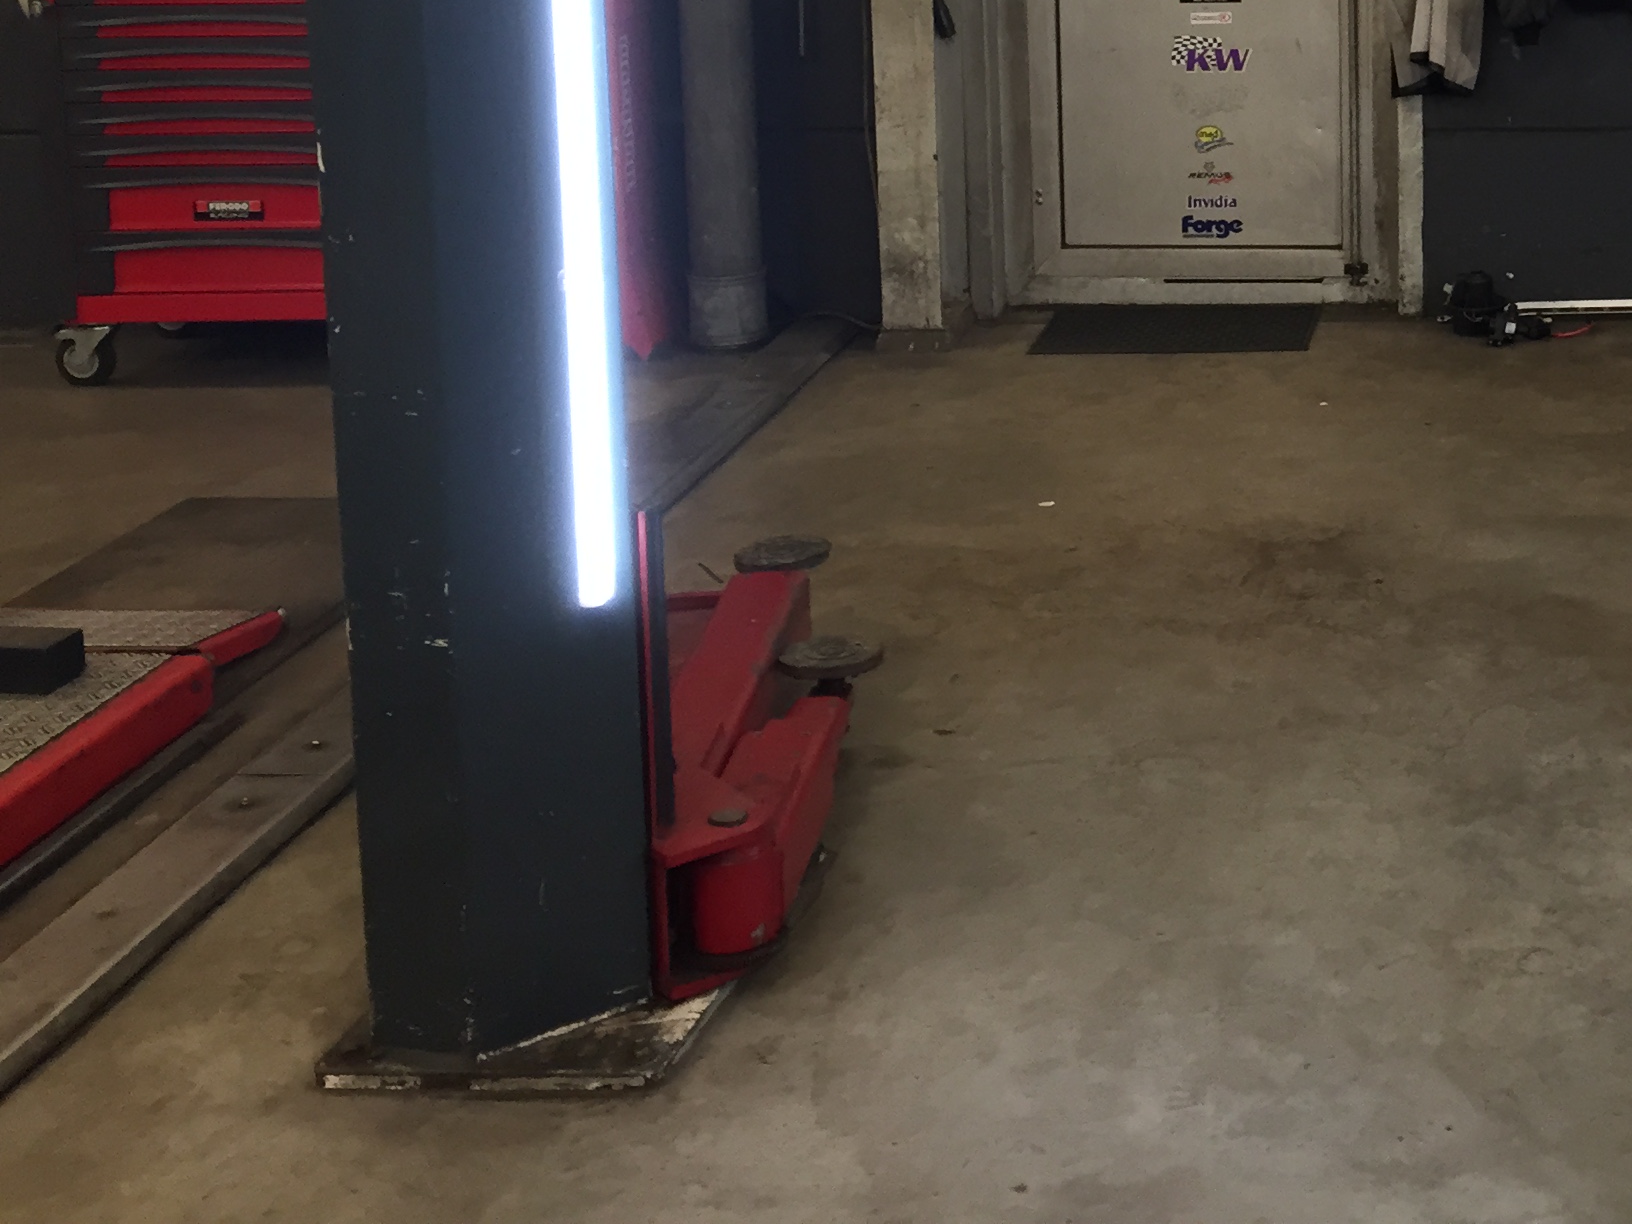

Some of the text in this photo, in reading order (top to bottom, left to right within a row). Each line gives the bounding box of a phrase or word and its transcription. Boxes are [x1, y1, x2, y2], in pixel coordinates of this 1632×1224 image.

[1186, 48, 1250, 72] KW
[209, 202, 248, 211] FERODO
[1187, 195, 1237, 208] Invidia
[1182, 215, 1243, 238] Forge
